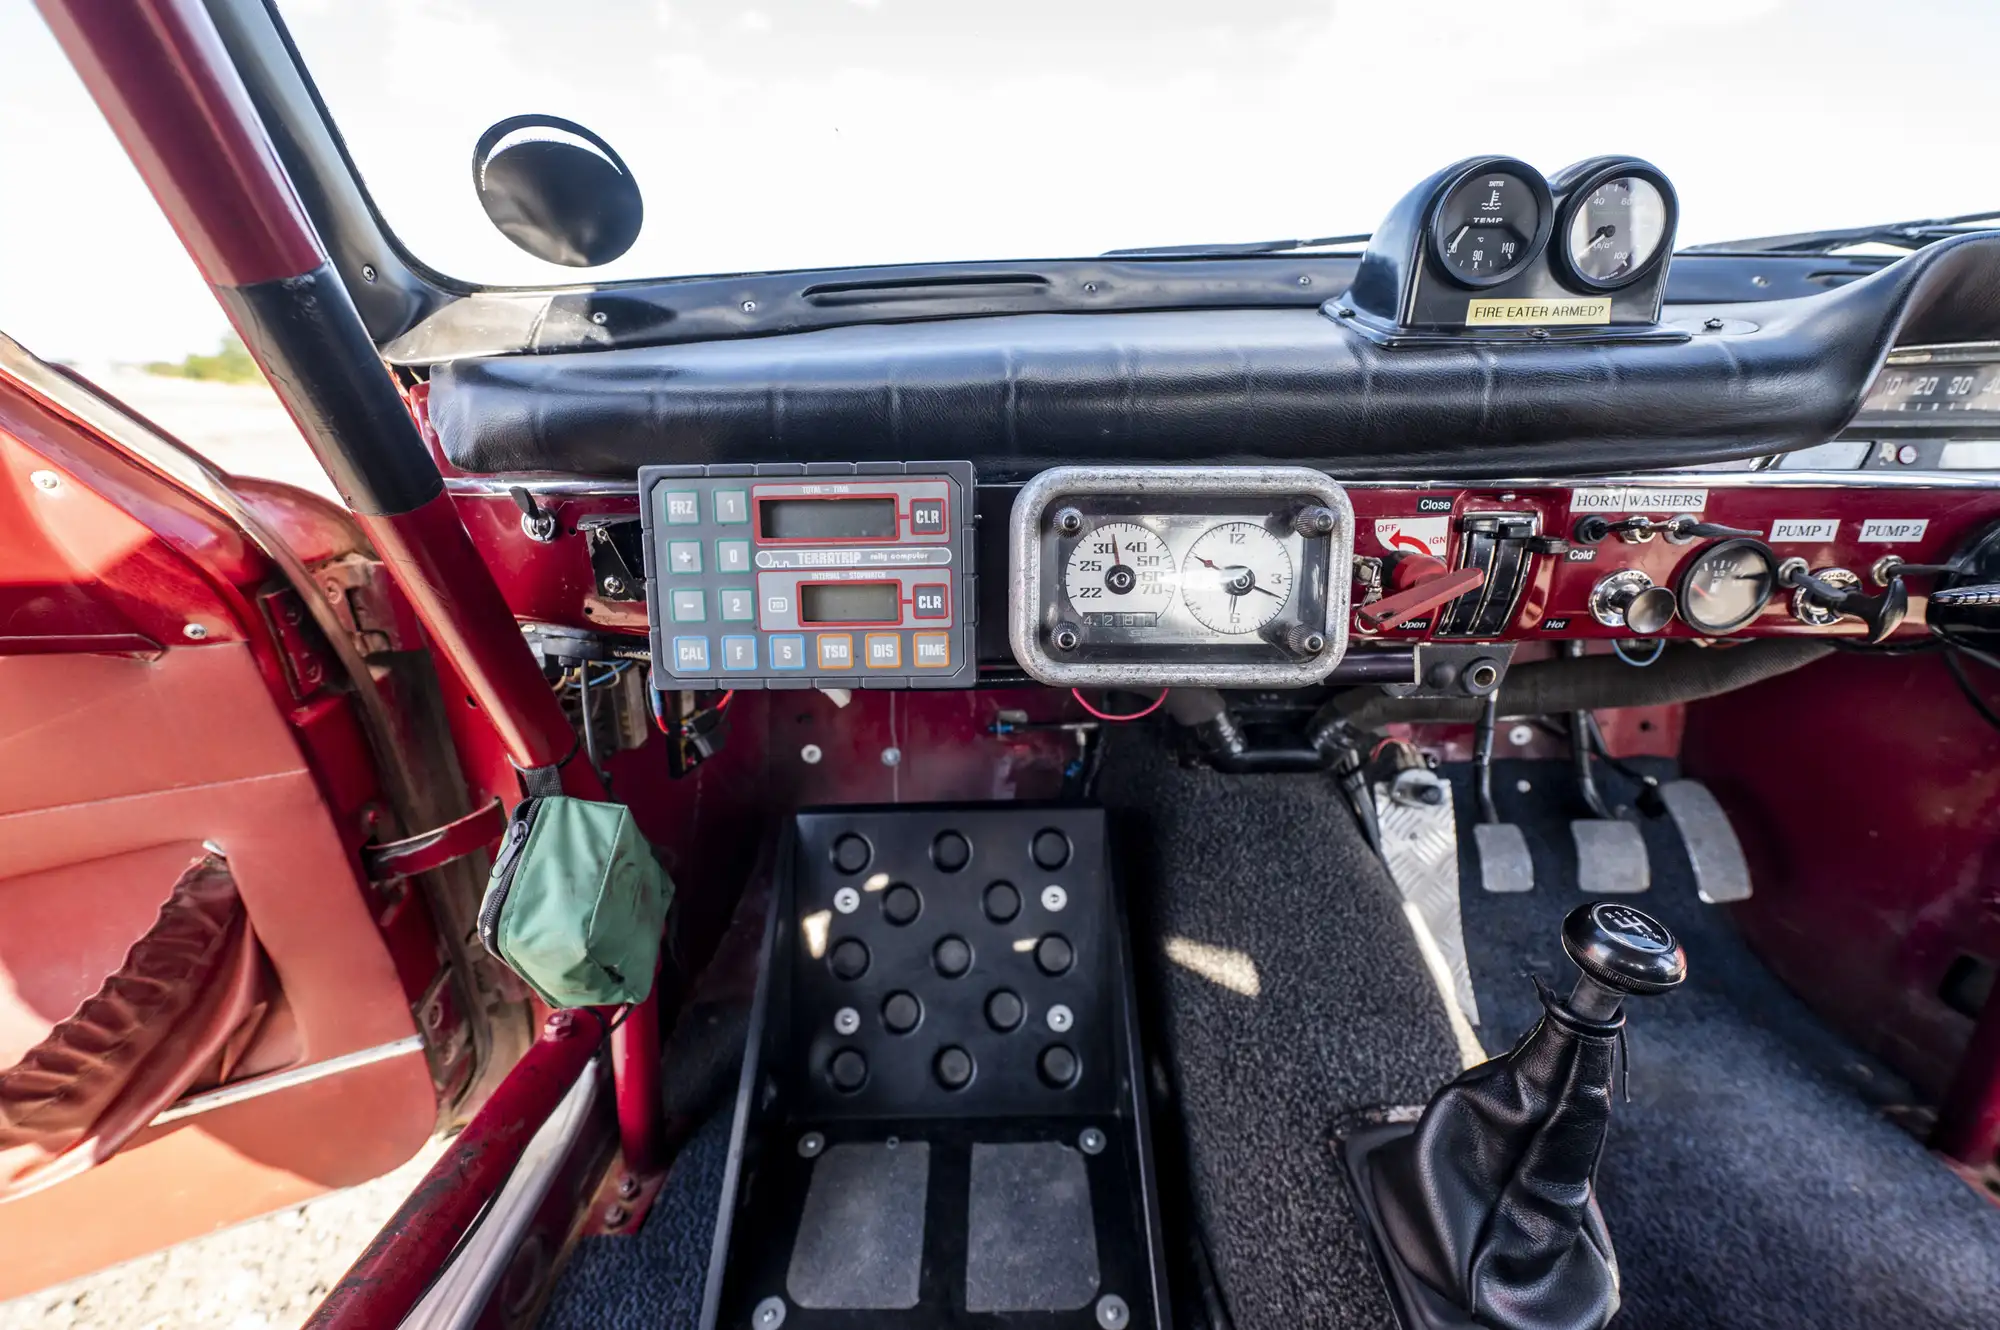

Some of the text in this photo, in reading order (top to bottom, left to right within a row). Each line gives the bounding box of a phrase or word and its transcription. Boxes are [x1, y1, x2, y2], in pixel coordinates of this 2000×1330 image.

[1593, 198, 1605, 206] 40
[1501, 242, 1515, 253] 140
[1472, 250, 1483, 261] 90
[1614, 252, 1627, 260] 100
[1474, 306, 1605, 318] FIRE EATER ARMED?
[1884, 377, 1902, 396] 10
[1913, 377, 1939, 395] 20
[1947, 376, 1974, 395] 30
[726, 499, 734, 513] 1
[1420, 500, 1451, 510] Close
[1576, 494, 1620, 507] HORN
[1629, 494, 1703, 507] WASHERS
[670, 500, 694, 515] FRZ
[915, 510, 940, 524] CLR
[1377, 524, 1397, 533] OFF
[1777, 525, 1832, 537] PUMP 1
[1865, 525, 1923, 537] PUMP 2
[1429, 536, 1446, 545] IGN
[1093, 543, 1116, 554] 30
[1125, 542, 1147, 553] 40
[797, 552, 862, 565] TERRATRIP
[890, 552, 929, 561] computer
[1569, 549, 1594, 560] Cold
[1080, 560, 1102, 572] 25
[1137, 556, 1160, 567] 50
[1271, 573, 1282, 584] 3
[1080, 587, 1102, 598] 22
[1140, 584, 1163, 595] 70
[732, 598, 742, 612] 2
[918, 595, 942, 609] CLR
[1399, 620, 1427, 630] Open
[1545, 620, 1566, 629] Hot
[680, 648, 704, 661] CAL
[735, 647, 743, 660] F
[783, 646, 792, 659] S
[824, 645, 848, 659] TSD
[873, 644, 894, 657] DIS
[918, 643, 945, 657] TIME
